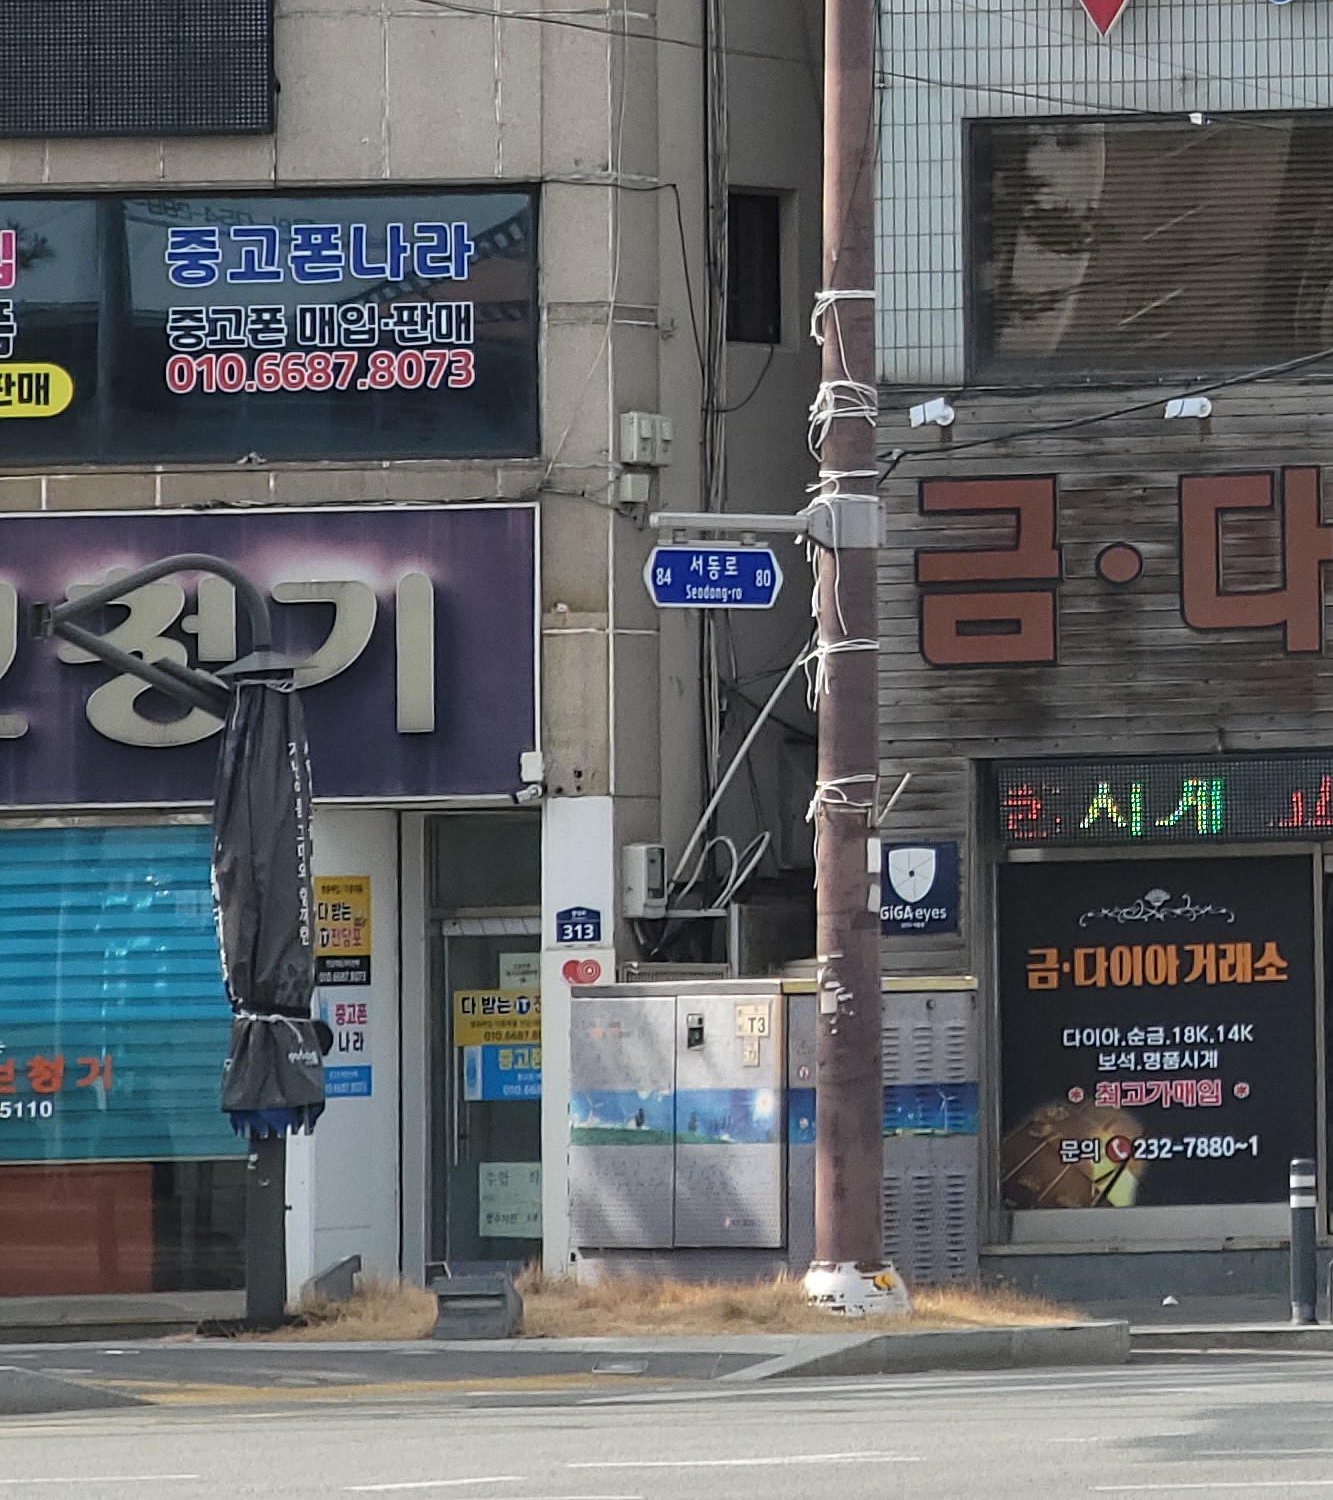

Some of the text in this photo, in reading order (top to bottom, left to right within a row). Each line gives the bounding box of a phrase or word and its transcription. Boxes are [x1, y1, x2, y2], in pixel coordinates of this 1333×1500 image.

[165, 222, 475, 288] 중고폰나라
[166, 305, 287, 351] 중고폰
[165, 349, 475, 394] 010.6687.8073
[656, 567, 672, 586] 84
[690, 554, 738, 581] 서동로
[755, 569, 771, 587] 80
[685, 583, 743, 603] Seodong-ro
[0, 566, 435, 748] 청기
[331, 902, 351, 921] 받는
[562, 924, 595, 940] 313
[1184, 941, 1289, 984] 거래소
[335, 1003, 367, 1026] 중고폰
[461, 996, 476, 1015] 다
[482, 996, 511, 1015] 받는
[747, 1016, 766, 1034] T3
[339, 1031, 364, 1053] 나라
[1094, 1080, 1223, 1110] 최고가매입
[1059, 1135, 1259, 1163] 문의 232-7880~1
